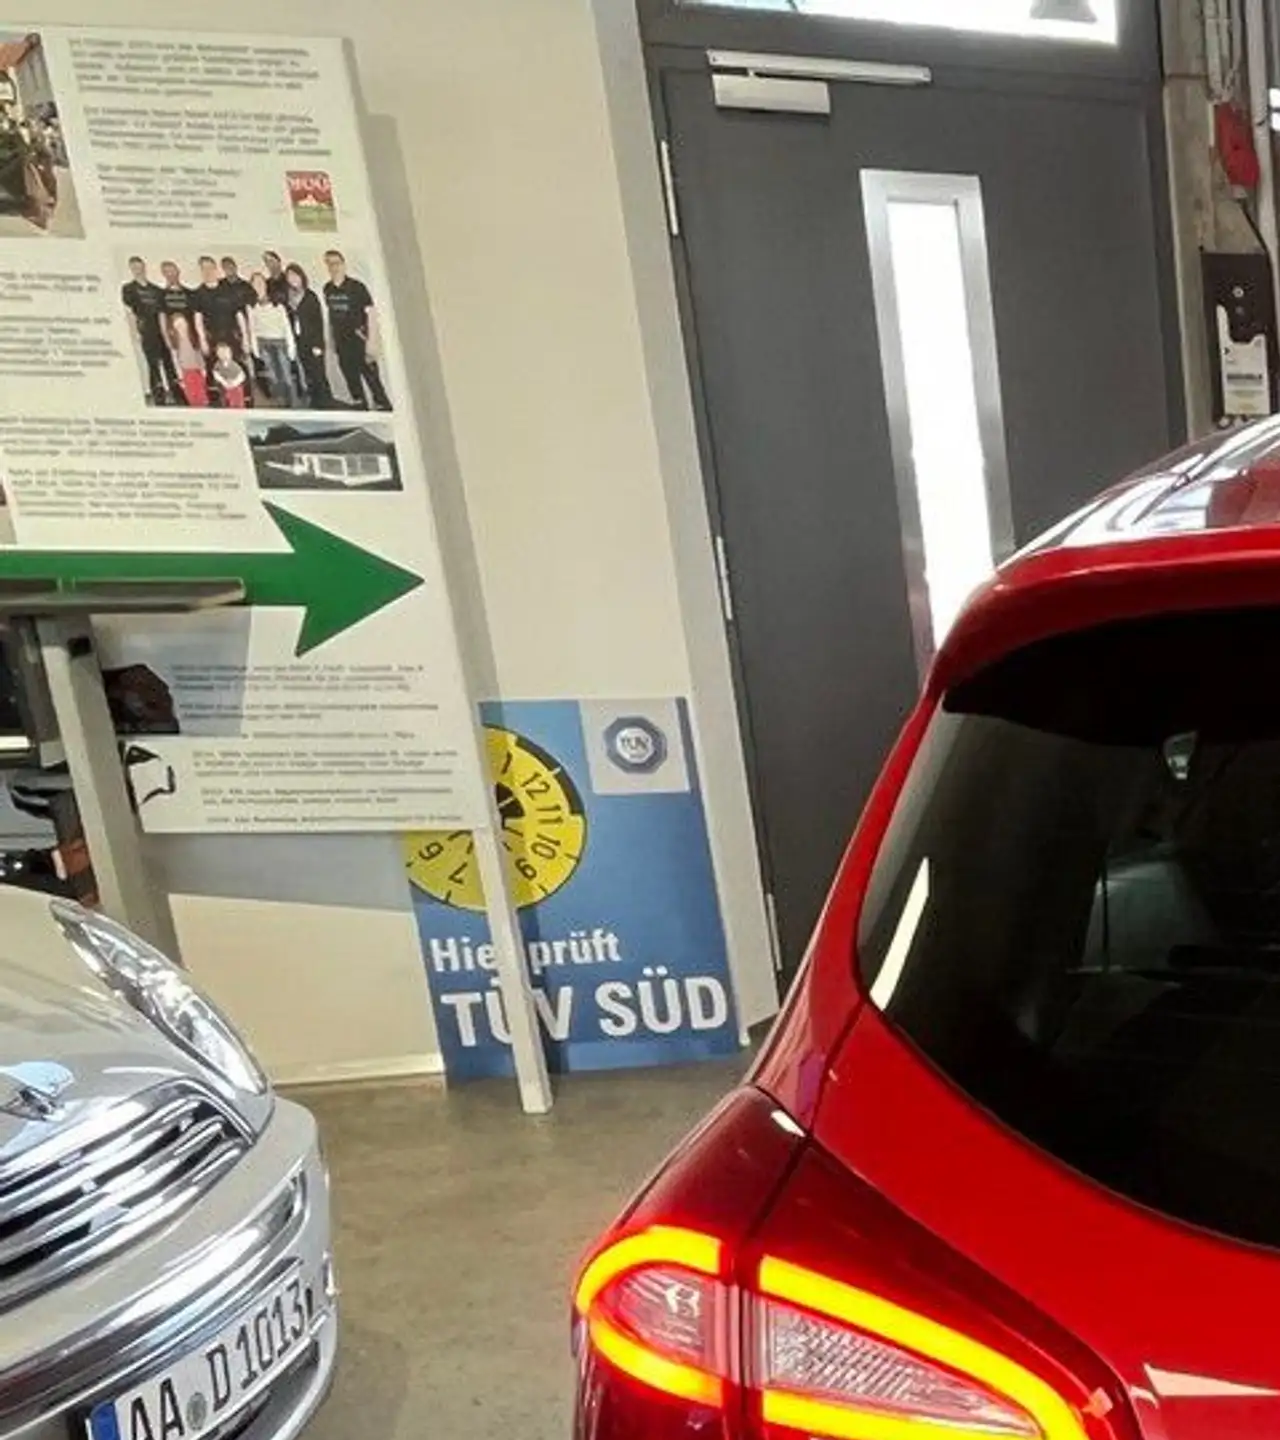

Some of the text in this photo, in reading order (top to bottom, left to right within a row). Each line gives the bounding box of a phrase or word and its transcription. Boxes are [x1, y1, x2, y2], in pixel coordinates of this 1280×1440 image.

[520, 772, 551, 801] 12
[536, 805, 563, 825] 11
[531, 833, 561, 860] 10
[429, 928, 622, 975] Hie prüft
[594, 965, 729, 1037] SÜD
[204, 1343, 232, 1413] D
[236, 1279, 307, 1391] 1013
